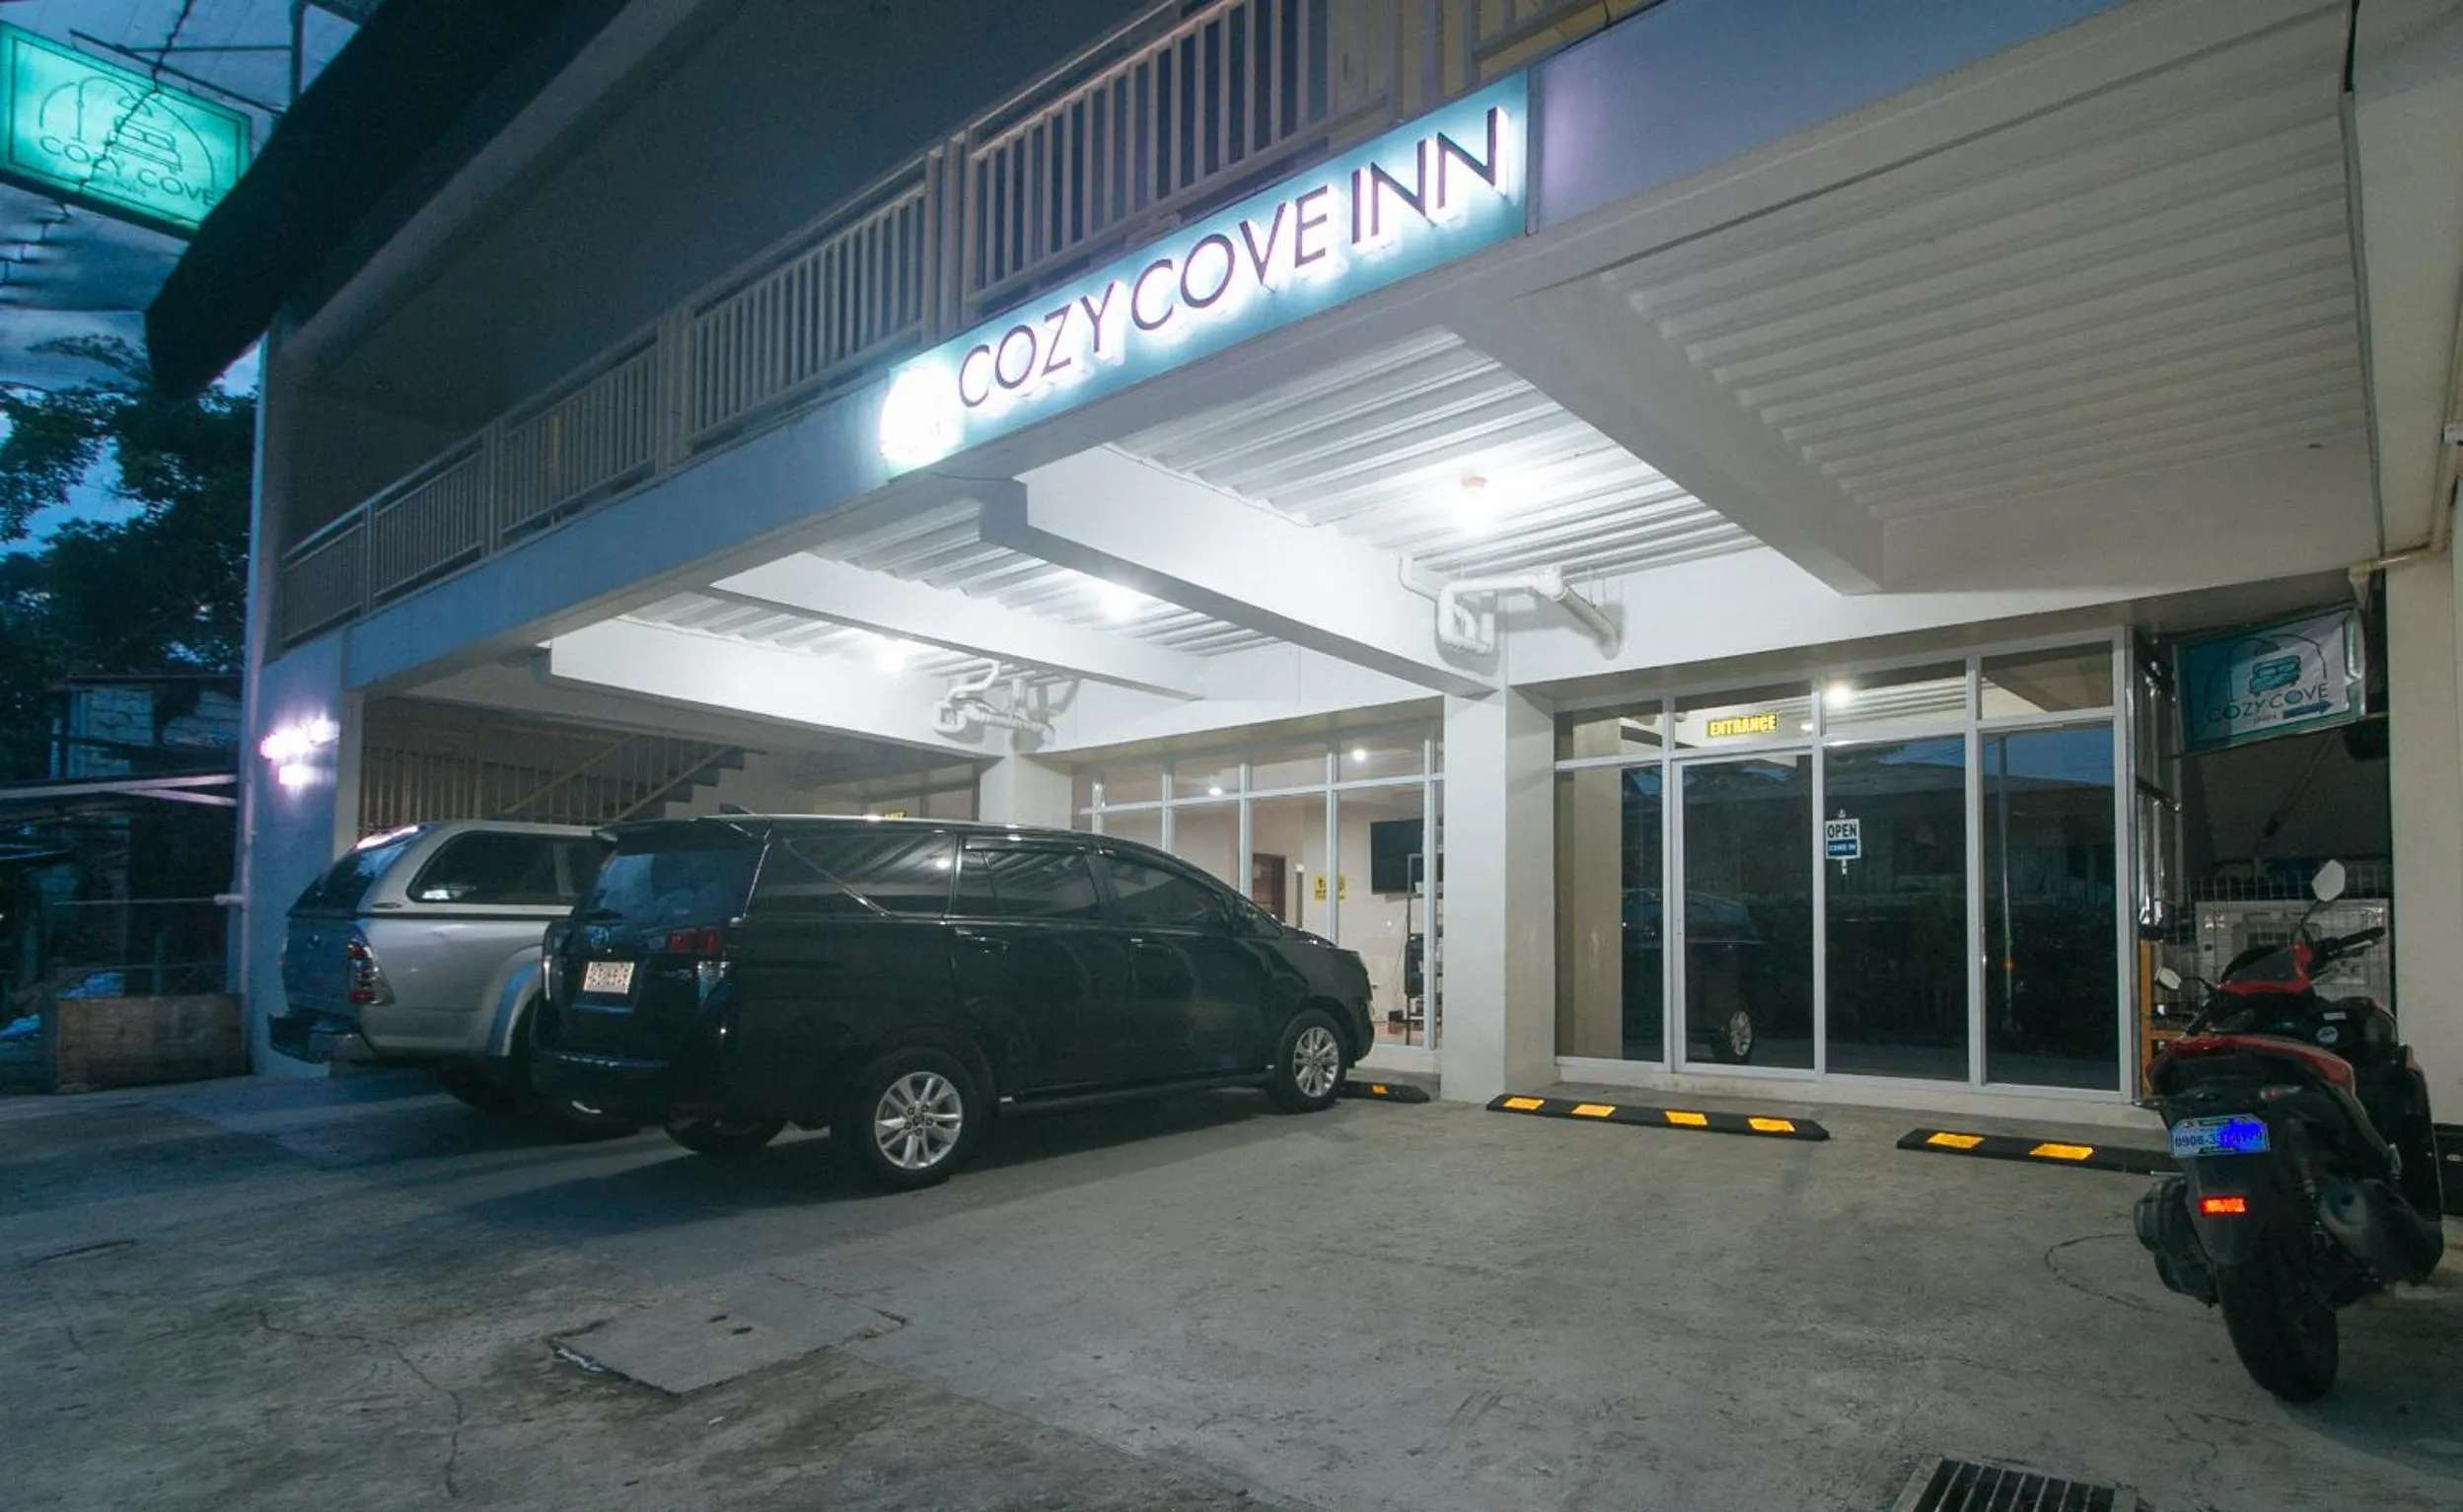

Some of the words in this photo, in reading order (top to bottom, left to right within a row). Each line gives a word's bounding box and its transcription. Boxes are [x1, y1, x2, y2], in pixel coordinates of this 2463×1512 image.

[138, 169, 216, 207] COVE
[958, 281, 1117, 408] COZY
[1129, 184, 1330, 331] COVE
[1350, 106, 1501, 245] INN
[2207, 699, 2266, 723] COZY
[2270, 682, 2329, 709] COVE
[1708, 712, 1777, 737] ENTRANCE
[1827, 823, 1856, 838] OPEN
